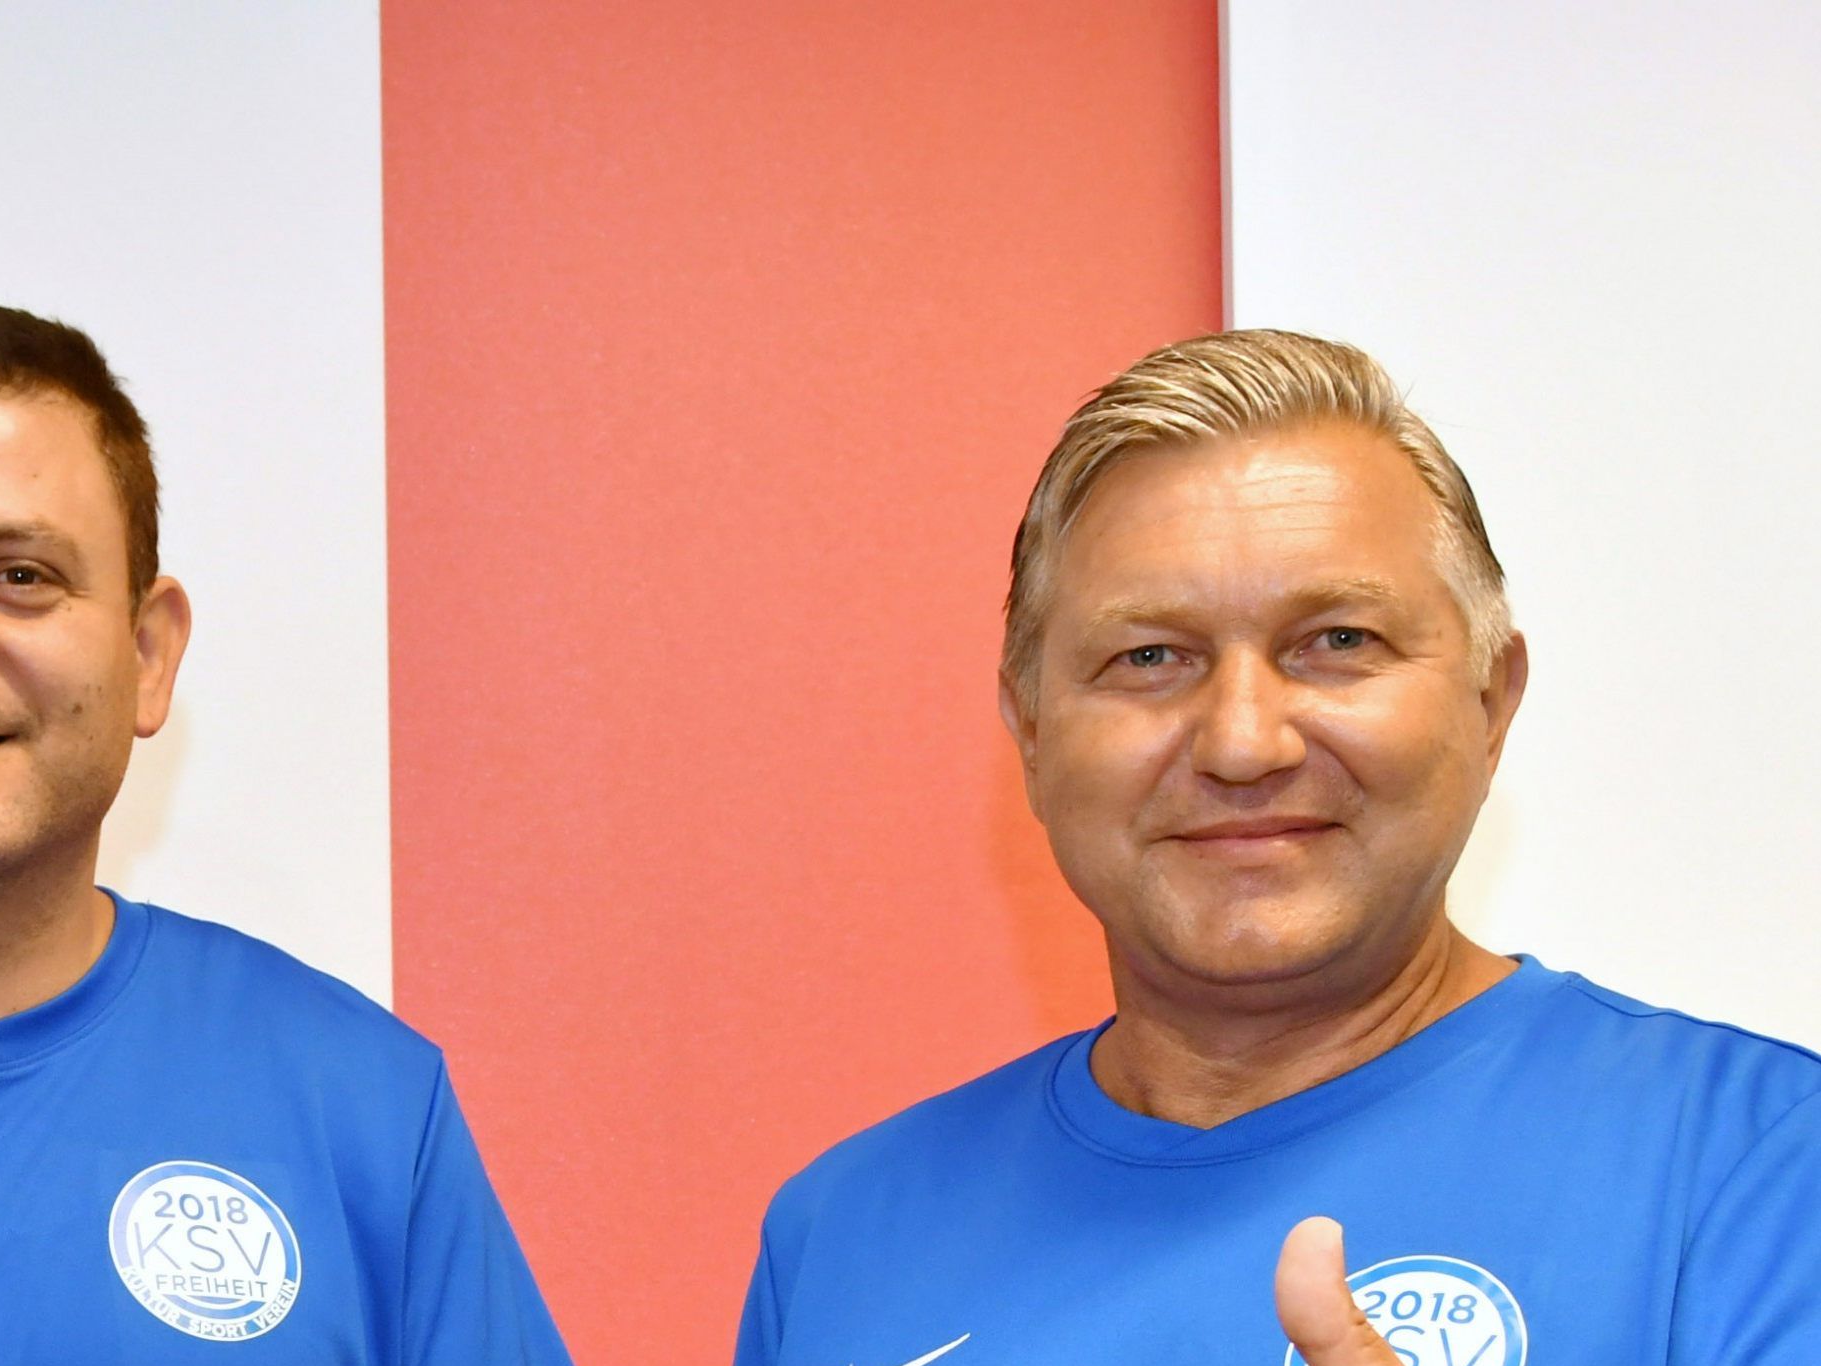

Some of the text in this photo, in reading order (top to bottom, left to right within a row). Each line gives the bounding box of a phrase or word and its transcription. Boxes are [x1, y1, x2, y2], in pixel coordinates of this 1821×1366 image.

[152, 1190, 249, 1226] 2018
[134, 1221, 272, 1277] KSV
[155, 1273, 269, 1299] FREIHEIT
[187, 1318, 249, 1340] SPORT
[253, 1277, 297, 1330] VEREIN
[1363, 1289, 1478, 1325] 2018
